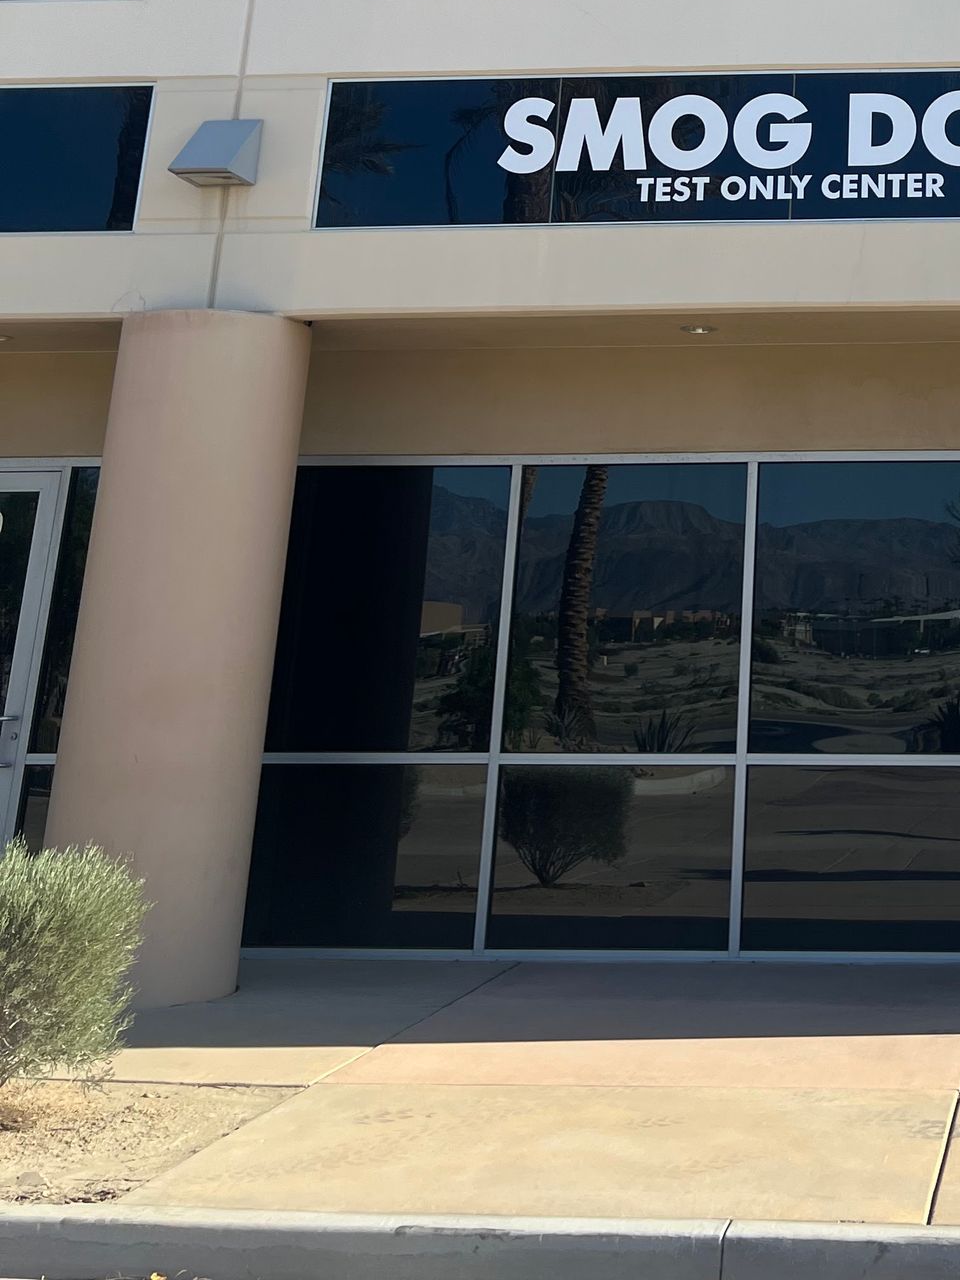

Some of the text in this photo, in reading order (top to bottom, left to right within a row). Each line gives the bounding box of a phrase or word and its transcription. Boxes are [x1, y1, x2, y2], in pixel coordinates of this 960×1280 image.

[497, 93, 812, 174] SMOG
[636, 173, 945, 202] TEST ONLY CENTER
